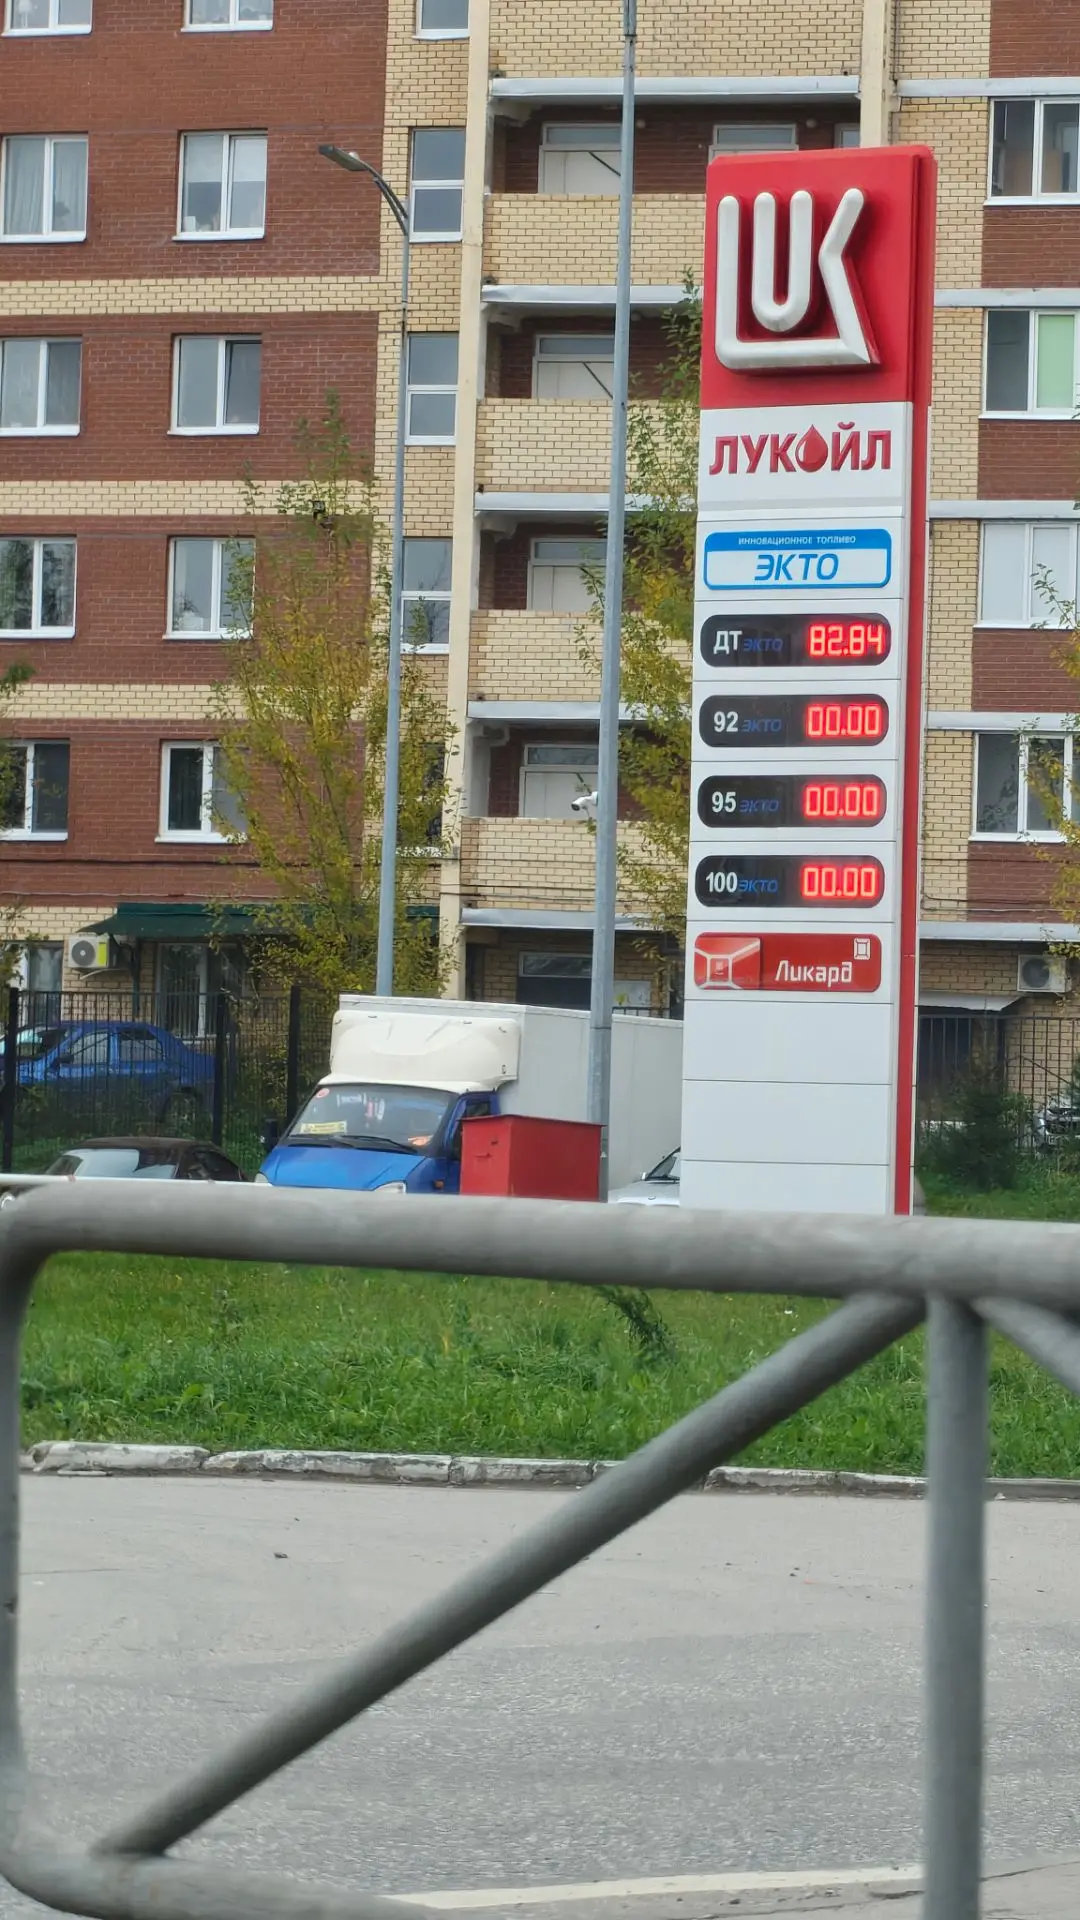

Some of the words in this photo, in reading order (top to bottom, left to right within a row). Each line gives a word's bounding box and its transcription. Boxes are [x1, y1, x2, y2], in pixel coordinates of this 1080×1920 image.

[709, 422, 892, 475] ЛУКОЙЛ
[738, 536, 812, 545] ИННОВАЦИОННОЕ
[816, 535, 856, 544] ТОПЛИВО
[754, 553, 839, 581] ЭКТО
[713, 630, 742, 654] ДТ
[743, 638, 783, 651] ЭКТО
[809, 624, 884, 656] 82.84
[714, 711, 738, 732] 92
[742, 719, 782, 732] ЭКТО
[808, 706, 880, 736] 00.00
[711, 791, 736, 813] 95
[739, 799, 779, 812] ЭКТО
[805, 786, 878, 816] 00.00
[706, 872, 737, 893] 100
[738, 879, 779, 893] ЭКТО
[803, 868, 876, 897] 00.00
[775, 960, 852, 987] Ликард
